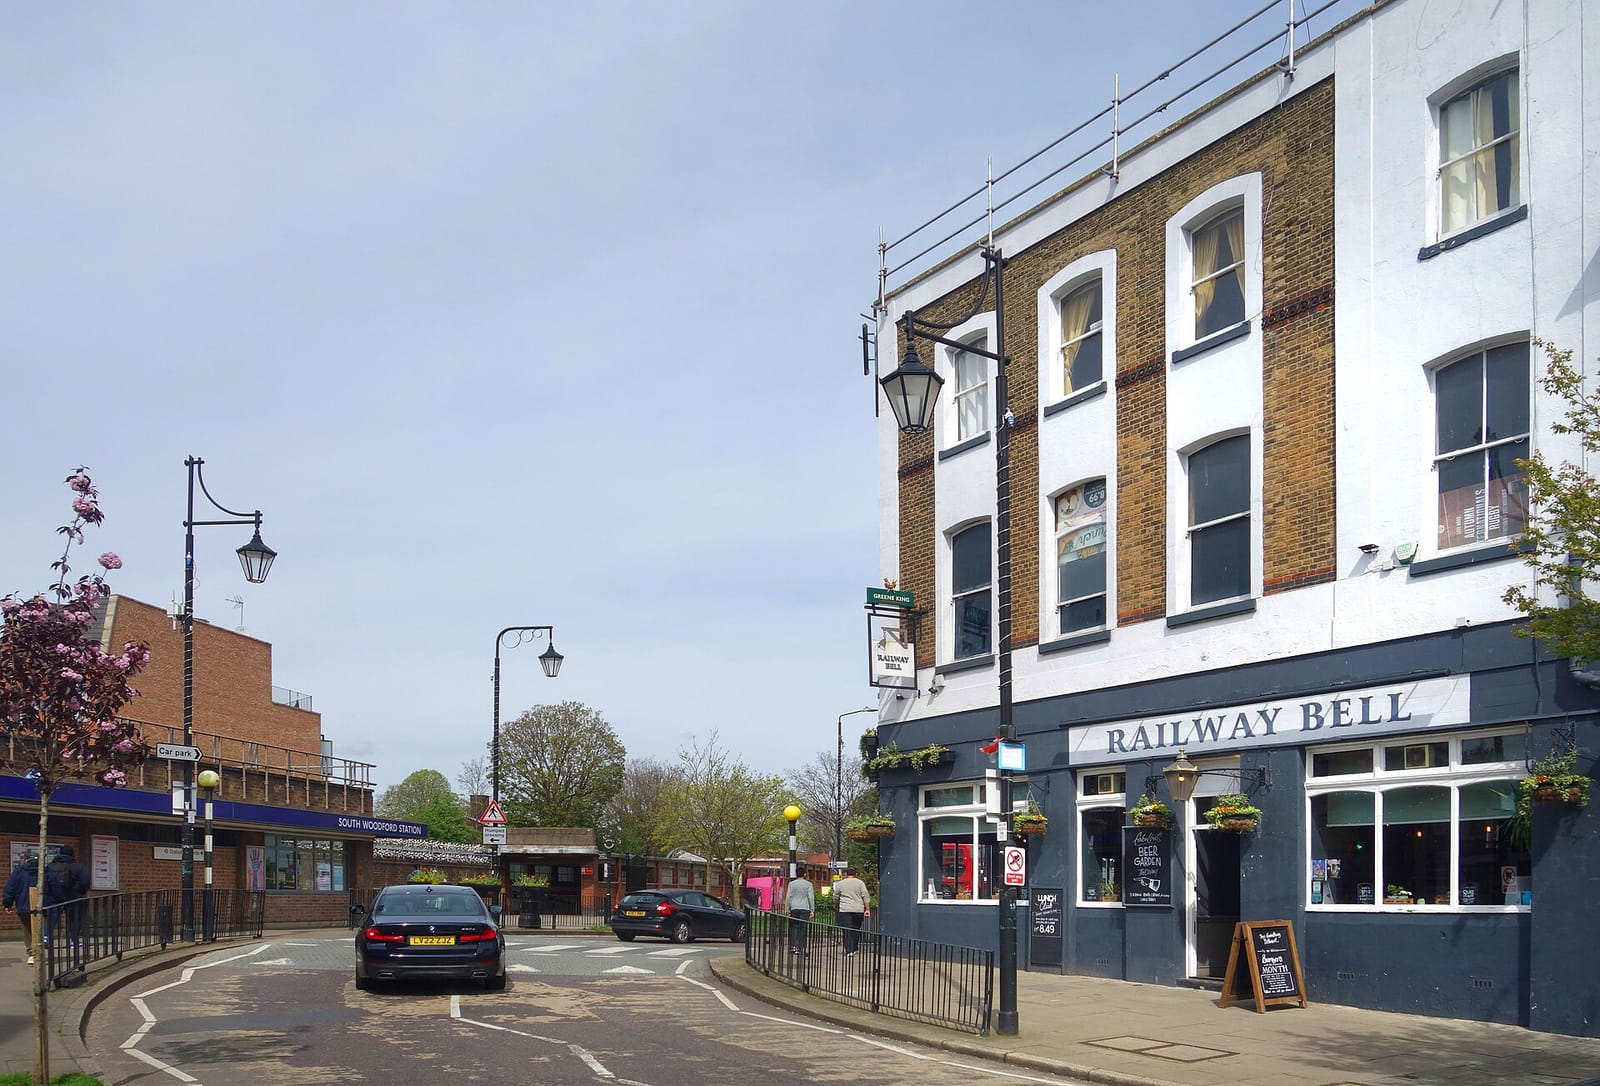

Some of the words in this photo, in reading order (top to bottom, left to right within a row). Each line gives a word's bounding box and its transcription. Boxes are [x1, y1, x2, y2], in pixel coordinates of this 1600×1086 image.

[1463, 506, 1475, 539] AUTUMN
[1488, 504, 1500, 530] RUGBY
[873, 593, 895, 601] GREENE
[895, 595, 910, 603] KING
[877, 654, 910, 664] RAILWAY
[885, 663, 902, 671] BELL
[1106, 706, 1282, 754] RAILWAY
[1299, 691, 1412, 732] BELL
[158, 747, 173, 755] Car
[175, 749, 192, 758] park
[338, 817, 361, 829] SOUTH
[362, 820, 398, 832] WOODFORD
[398, 824, 422, 835] STATION
[1138, 845, 1158, 857] BEER
[1133, 856, 1162, 867] GARDEN
[1037, 894, 1057, 902] LUNCH
[413, 936, 434, 944] LV22
[1262, 965, 1288, 974] MONTH
